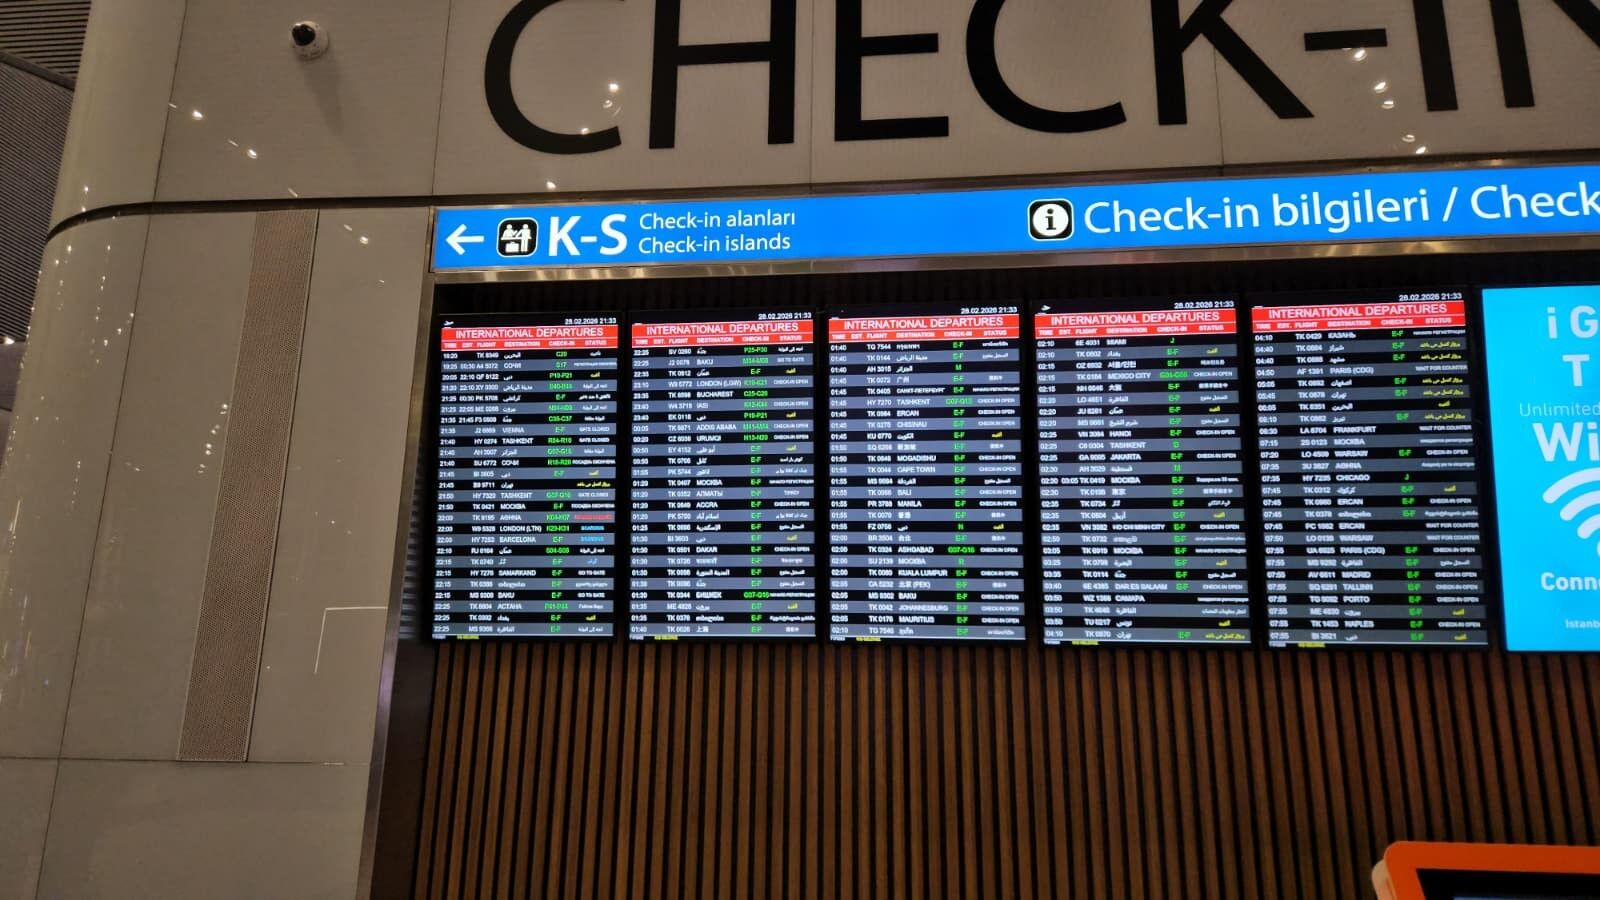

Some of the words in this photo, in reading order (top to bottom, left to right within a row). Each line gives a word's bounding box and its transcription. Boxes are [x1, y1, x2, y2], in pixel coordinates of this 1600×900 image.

[1085, 197, 1259, 233] Check-in
[1273, 189, 1428, 233] bilgileri
[1443, 187, 1457, 221] /
[640, 212, 720, 229] Check-in
[727, 210, 794, 226] alanları
[549, 214, 627, 256] K-S
[639, 236, 719, 253] Check-in
[726, 233, 790, 250] islands
[1441, 292, 1461, 301] 21:33
[998, 306, 1017, 314] 21:33
[1214, 300, 1233, 308] 21:33
[1269, 306, 1362, 319] INTERNATIONAL
[1365, 303, 1446, 315] DEPARTURES
[844, 318, 927, 329] INTERNATIONAL
[930, 317, 1002, 327] DEPARTURES
[1051, 313, 1139, 325] INTERNATIONAL
[1142, 311, 1219, 322] DEPARTURES
[1294, 321, 1318, 330] FLIGHT
[1425, 317, 1451, 325] STATUS
[456, 328, 533, 338] INTERNATIONAL
[536, 326, 603, 337] DEPARTURES
[647, 323, 726, 334] INTERNATIONAL
[729, 321, 798, 332] DEPARTURES
[1075, 328, 1097, 336] FLIGHT
[866, 331, 887, 340] FLIGHT
[830, 342, 846, 350] 01:40
[1542, 573, 1600, 590] Conn
